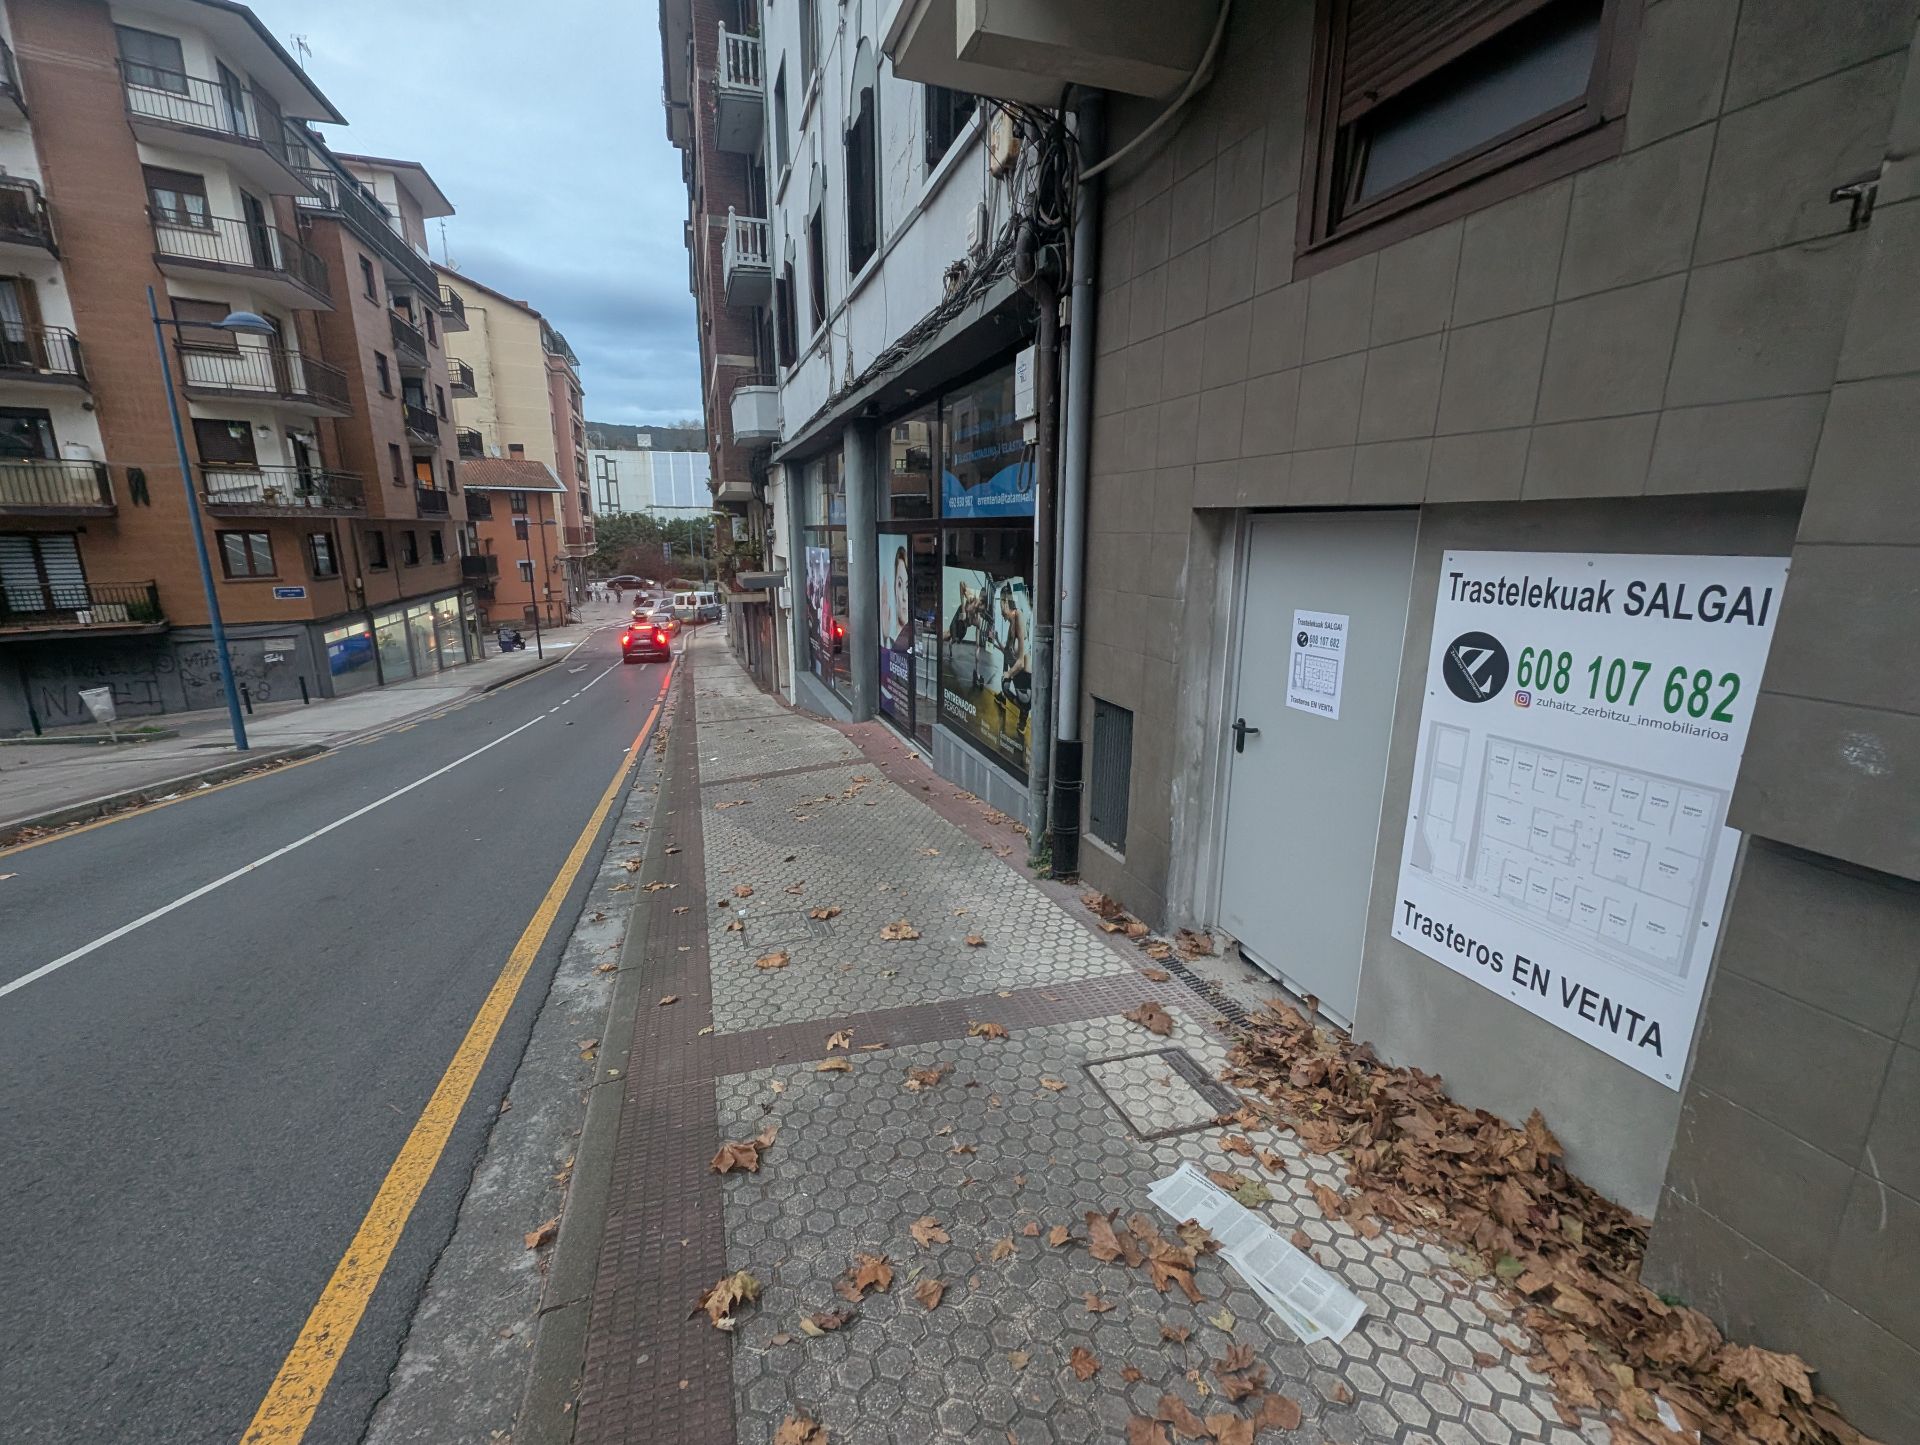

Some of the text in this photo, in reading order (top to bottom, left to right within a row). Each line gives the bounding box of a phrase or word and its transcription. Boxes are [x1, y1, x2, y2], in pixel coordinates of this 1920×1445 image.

[1449, 572, 1772, 627] Trastelekuak SALGAI
[1330, 638, 1340, 648] 682
[943, 688, 977, 717] ENTRENADOR
[1517, 646, 1742, 723] 608 107 682
[943, 698, 969, 723] PERSONAL
[1310, 700, 1318, 709] EN
[1318, 702, 1334, 713] VENTA
[1535, 694, 1730, 742] zuhaitz_zerbitzu_inmobiliarioa
[1403, 900, 1664, 1057] Trasteros EN VENTA
